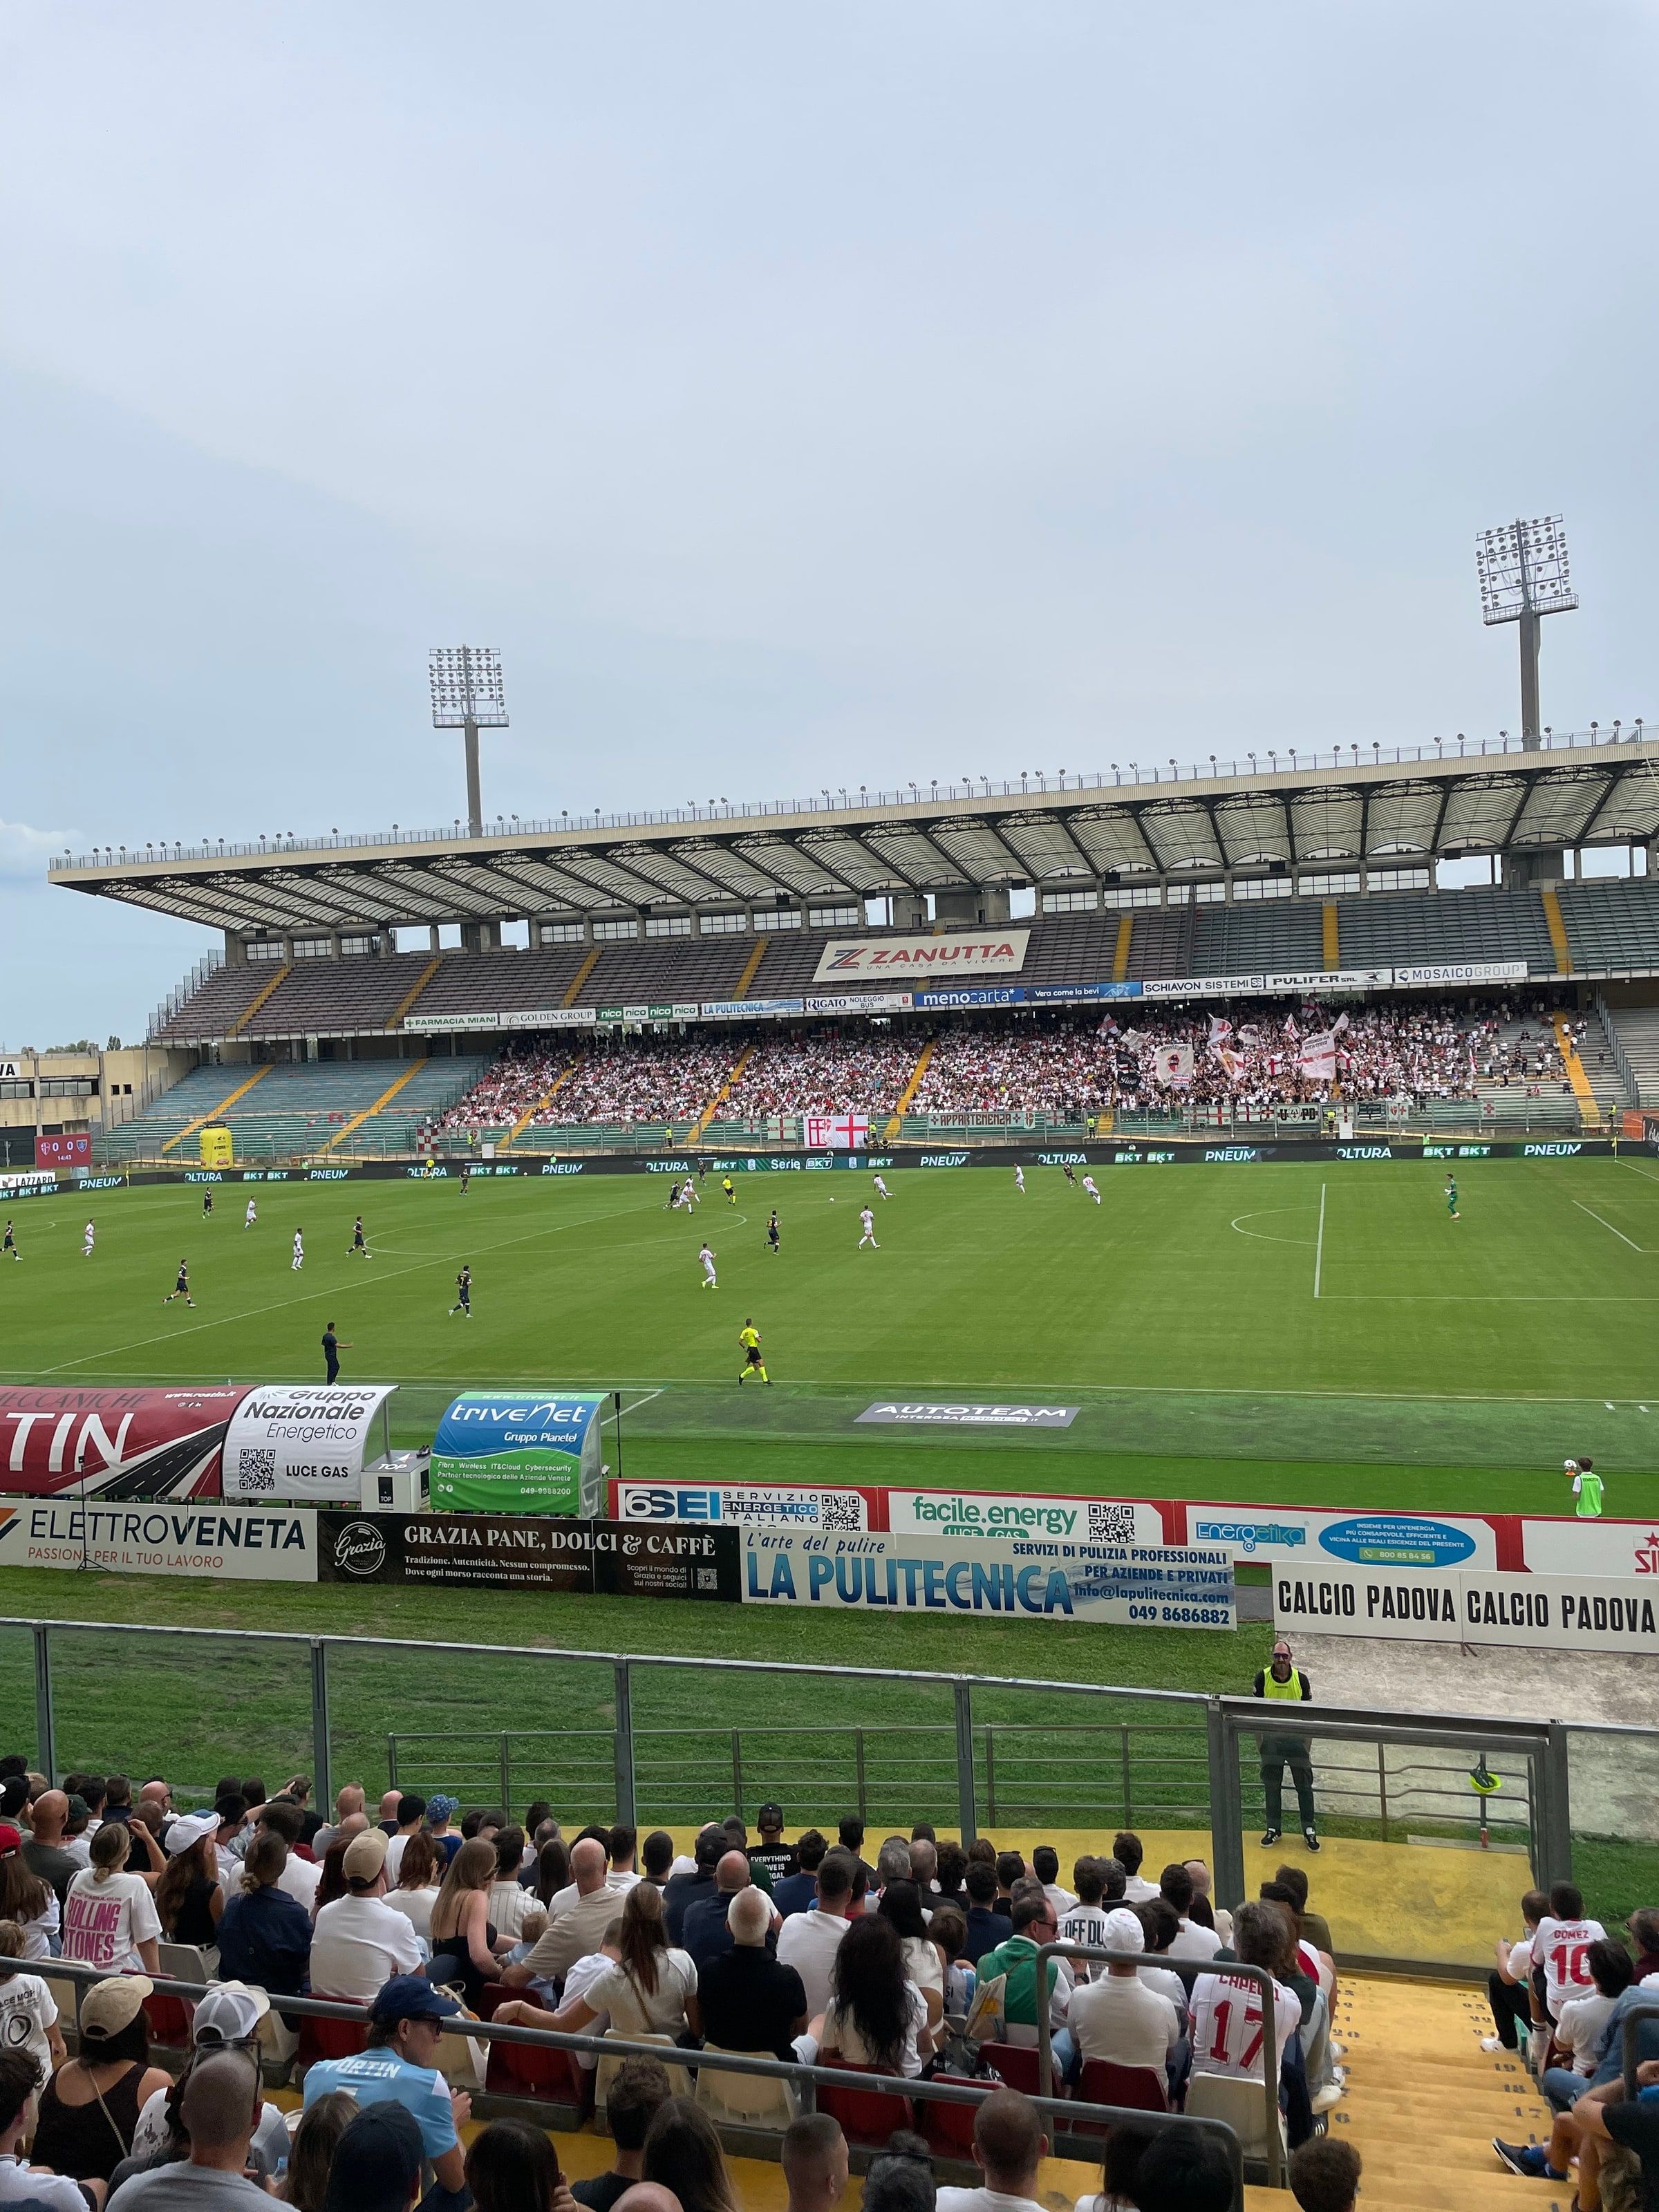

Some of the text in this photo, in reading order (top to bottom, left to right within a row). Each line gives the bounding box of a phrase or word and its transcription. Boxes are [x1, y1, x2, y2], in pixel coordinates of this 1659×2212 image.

[869, 944, 1015, 964] ZANUTTA
[1145, 982, 1201, 992] SCHIAVON
[1205, 980, 1248, 989] SISTEMI
[1273, 975, 1340, 985] PULIFER
[1035, 988, 1051, 997] Vera
[1075, 987, 1082, 995] la
[1083, 986, 1099, 995] bevi
[601, 1009, 621, 1018] nico
[704, 1004, 713, 1014] LA
[716, 1003, 764, 1013] PULITECNICA
[415, 1018, 464, 1026] FARMACIA
[521, 1012, 592, 1022] GOLDEN GROUP
[53, 1141, 73, 1152] 0 0
[1423, 1146, 1490, 1157] BKT BKT
[868, 1158, 893, 1168] BKT
[1115, 1152, 1175, 1163] BKT BKT
[713, 1161, 737, 1170] BKT
[771, 1158, 831, 1170] Serie BKT
[243, 1172, 288, 1181] BKT BKT
[470, 1166, 518, 1175] BKT BKT
[19, 1184, 59, 1197] BKT BKT
[165, 1391, 236, 1400] www.rostin.it
[289, 1390, 376, 1404] Gruppo
[243, 1402, 365, 1421] Nazionale
[874, 1405, 1067, 1417] AUTOTEAM
[267, 1423, 357, 1443] Energetico
[504, 1432, 577, 1444] Gruppo Planetel
[285, 1465, 348, 1478] LUCE GAS
[491, 1463, 521, 1471] IT&Cloud
[525, 1464, 572, 1472] Cybersecurity
[722, 1491, 818, 1502] SERVIZIO
[723, 1502, 818, 1514] ENERGETICO
[722, 1512, 818, 1524] ITALIANO
[912, 1496, 1077, 1535] facile.energy
[30, 1509, 306, 1550] ELETTROVENETA
[1358, 1530, 1405, 1539] CONSAPEVOLE,
[404, 1526, 716, 1556] GRAZIA PANE, DOLCI & CAFFÈ
[747, 1533, 885, 1555] L'arte del pulire
[28, 1546, 223, 1568] PASSIONE PER IL TUO LAVORO
[334, 1536, 386, 1566] Grazia
[1013, 1542, 1227, 1565] SERVIZI DI PULIZIA PROFESSIONALI
[404, 1555, 590, 1572] Tradizione. Autenticità. Nessun compromesso.
[626, 1564, 648, 1573] Scopri
[405, 1567, 424, 1576] Dove
[426, 1568, 444, 1578] ogni
[472, 1571, 508, 1580] racconta
[526, 1573, 553, 1582] storia.
[662, 1573, 687, 1582] seguici
[1085, 1565, 1228, 1584] PER AZIENDE E PRIVATI
[747, 1552, 1074, 1615] LA PULITECNICA
[1074, 1583, 1229, 1604] info@lapulitecnica.com
[1278, 1580, 1658, 1634] CALCIO PADOVA CALCIO PADOVA
[1129, 1604, 1230, 1624] 049 8686882
[750, 1854, 791, 1863] EVERYTHING
[66, 1896, 122, 1932] ROLLING
[1065, 1919, 1086, 1942] OFF
[1554, 1930, 1589, 1939] GOMEZ
[63, 1928, 115, 1962] STONES
[1210, 1999, 1264, 2072] 17
